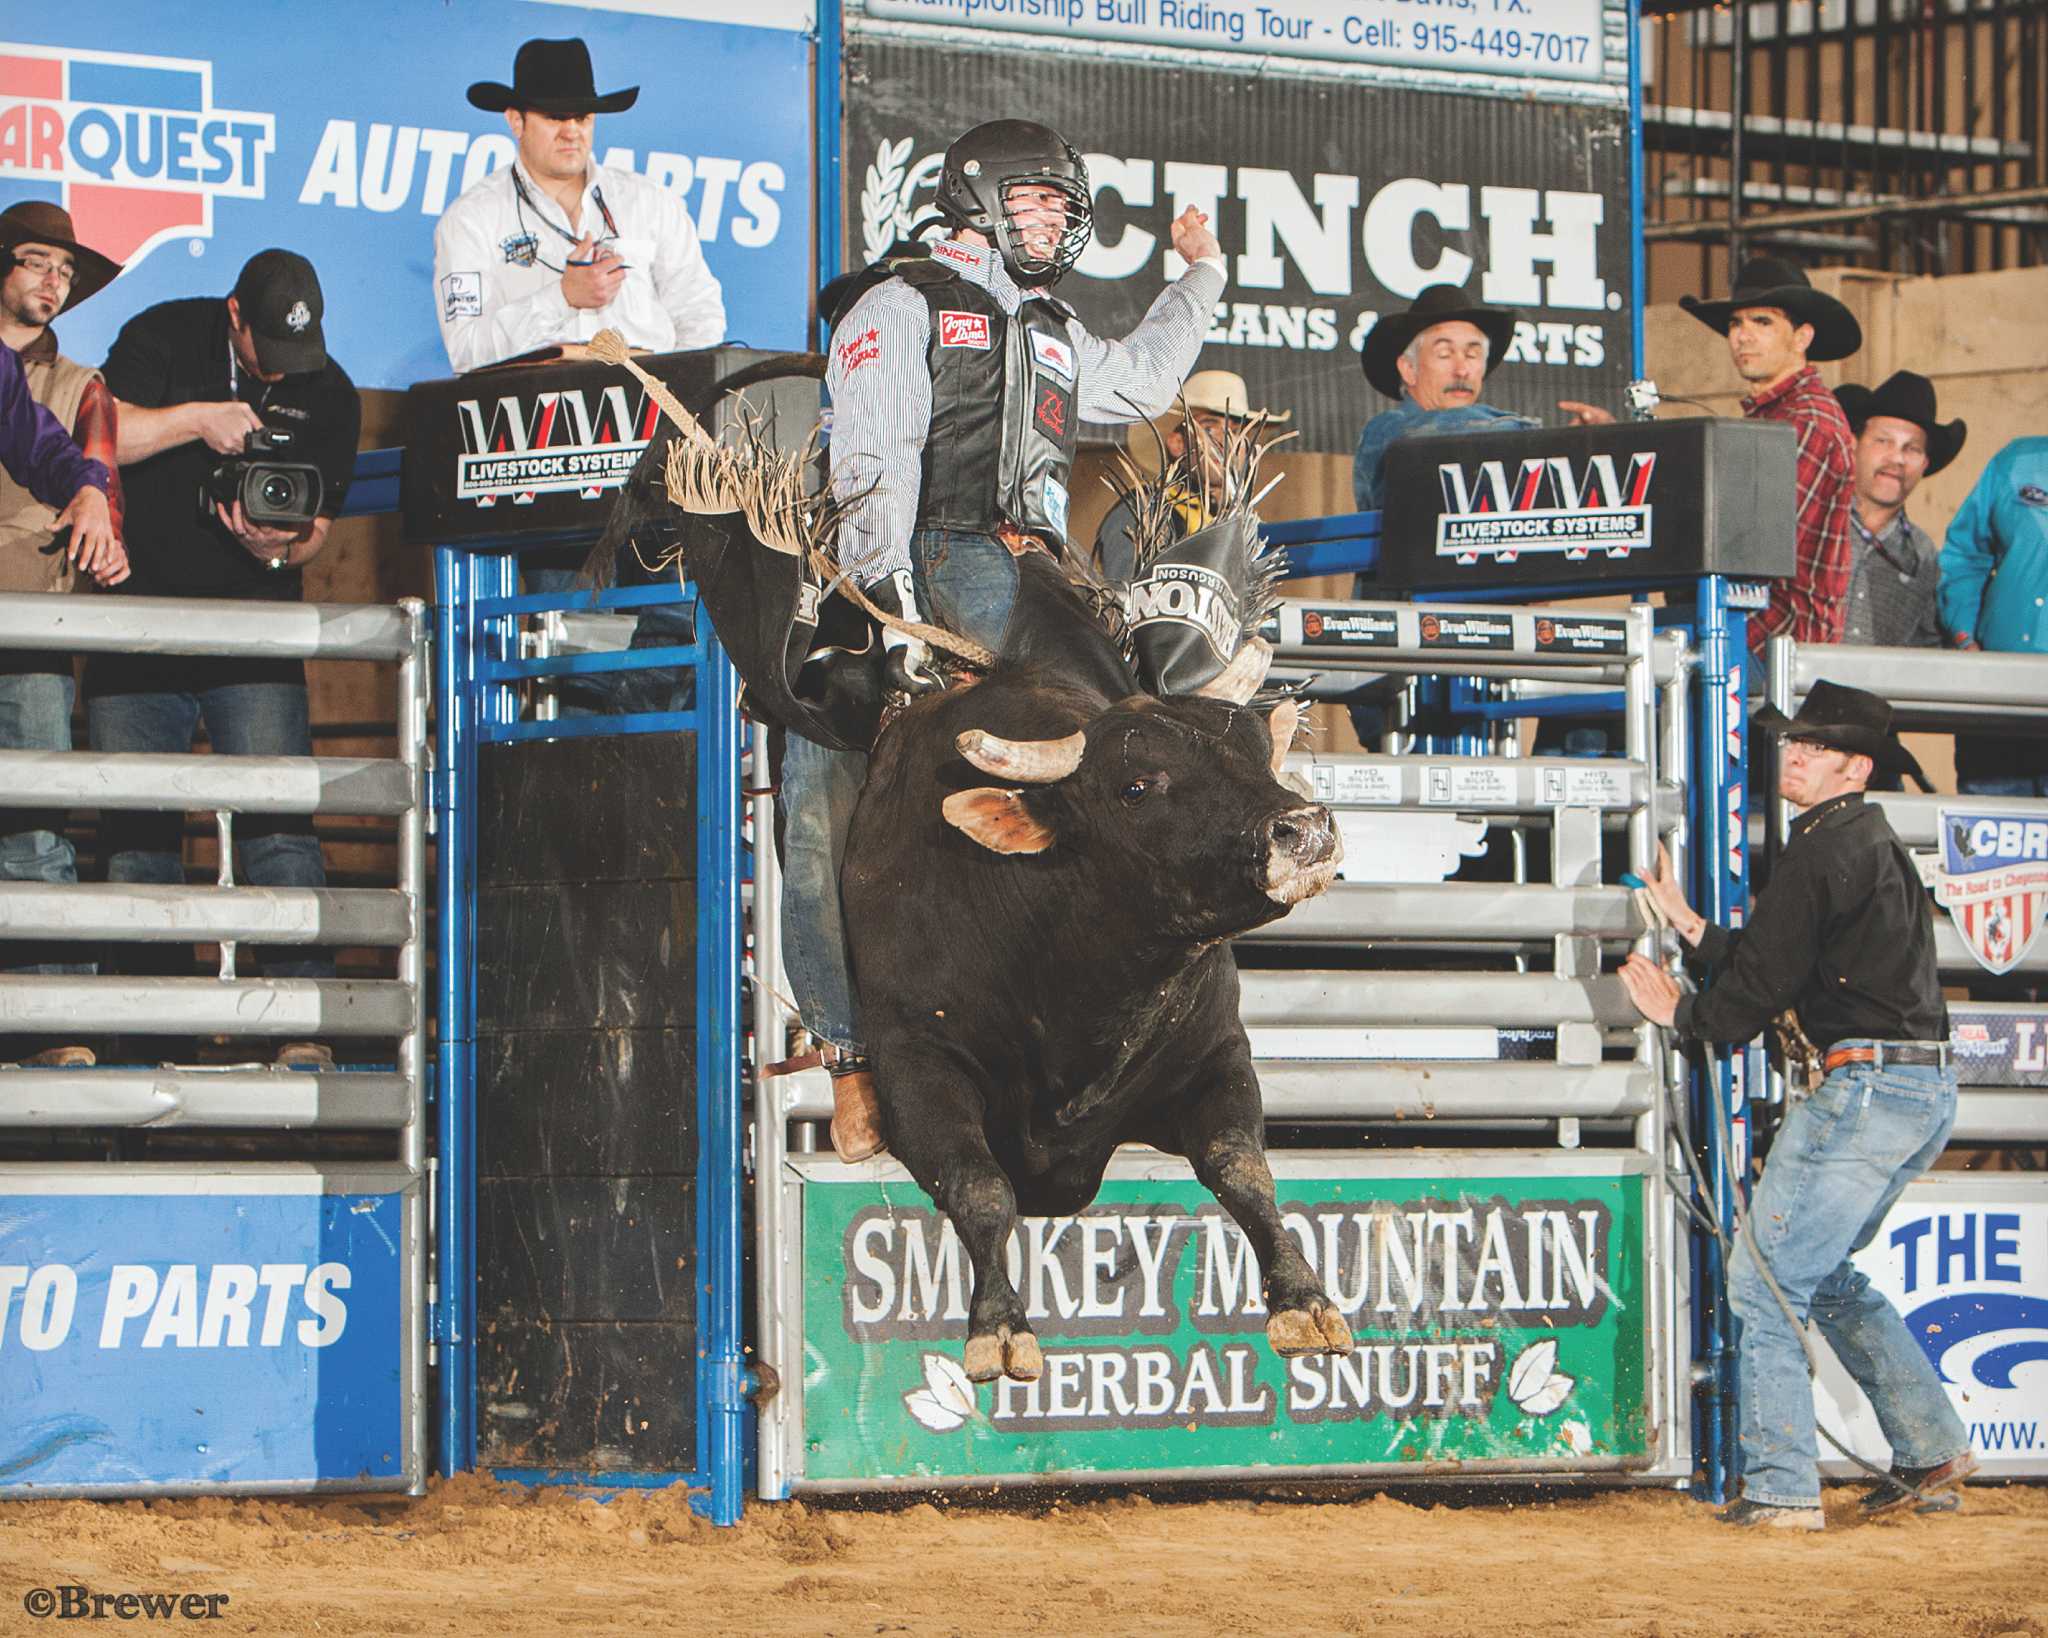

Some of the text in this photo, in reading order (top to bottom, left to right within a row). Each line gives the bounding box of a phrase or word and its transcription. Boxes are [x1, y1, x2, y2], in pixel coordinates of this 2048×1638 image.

[1097, 0, 1146, 25] Bull
[1161, 0, 1245, 42] Riding
[1256, 8, 1313, 39] Tour
[1343, 16, 1401, 48] Cell:
[1412, 22, 1590, 64] 915-449-7017
[1070, 152, 1606, 311] CINCH
[943, 315, 973, 333] Tony
[1203, 303, 1338, 351] EANS
[470, 456, 564, 480] LIVESTOCK
[568, 451, 643, 473] SYSTEM
[1450, 515, 1637, 538] LIVESTOCK SYSTEMS
[1972, 820, 2048, 859] CBR
[1890, 1212, 2022, 1294] THE
[99, 1262, 352, 1348] PARTS
[993, 1343, 1496, 1419] HERBAL SNUFF
